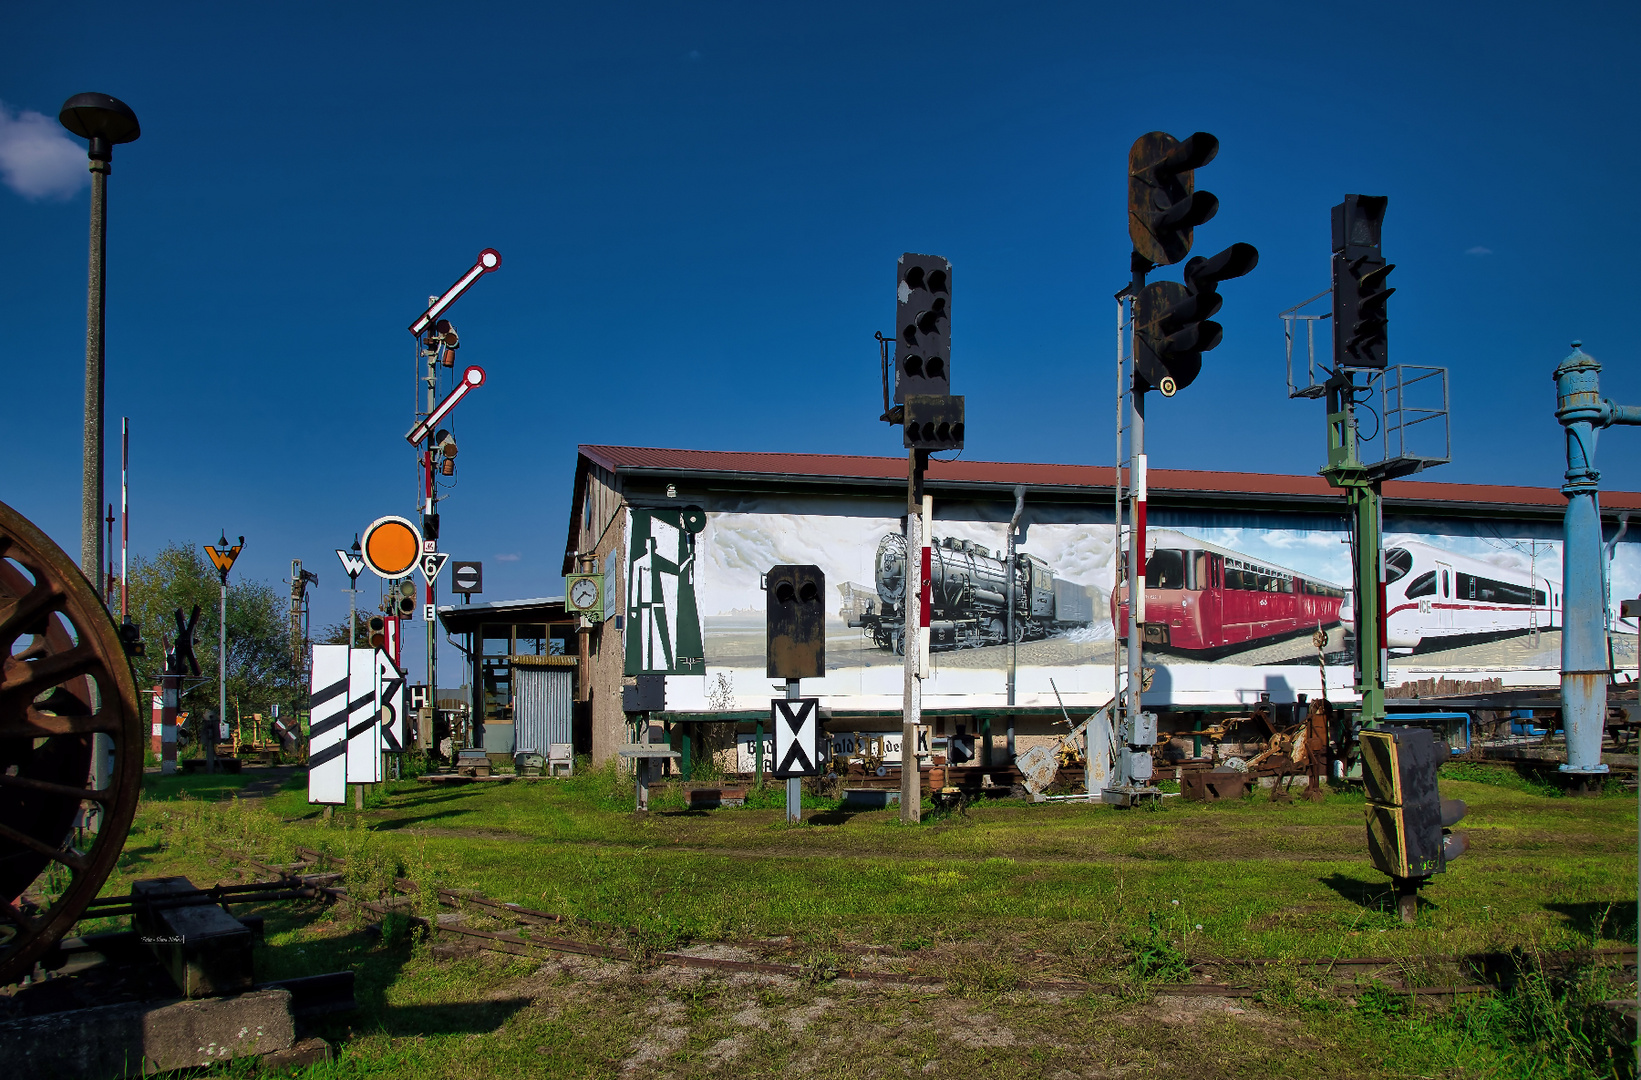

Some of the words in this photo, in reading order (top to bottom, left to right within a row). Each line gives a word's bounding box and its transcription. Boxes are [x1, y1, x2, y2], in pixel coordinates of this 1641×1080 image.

[203, 545, 243, 572] W
[335, 549, 366, 577] W
[424, 555, 438, 576] 6
[426, 606, 433, 619] E
[1419, 600, 1432, 614] ICE
[411, 687, 427, 708] H
[746, 739, 773, 755] Bd
[917, 730, 929, 752] K
